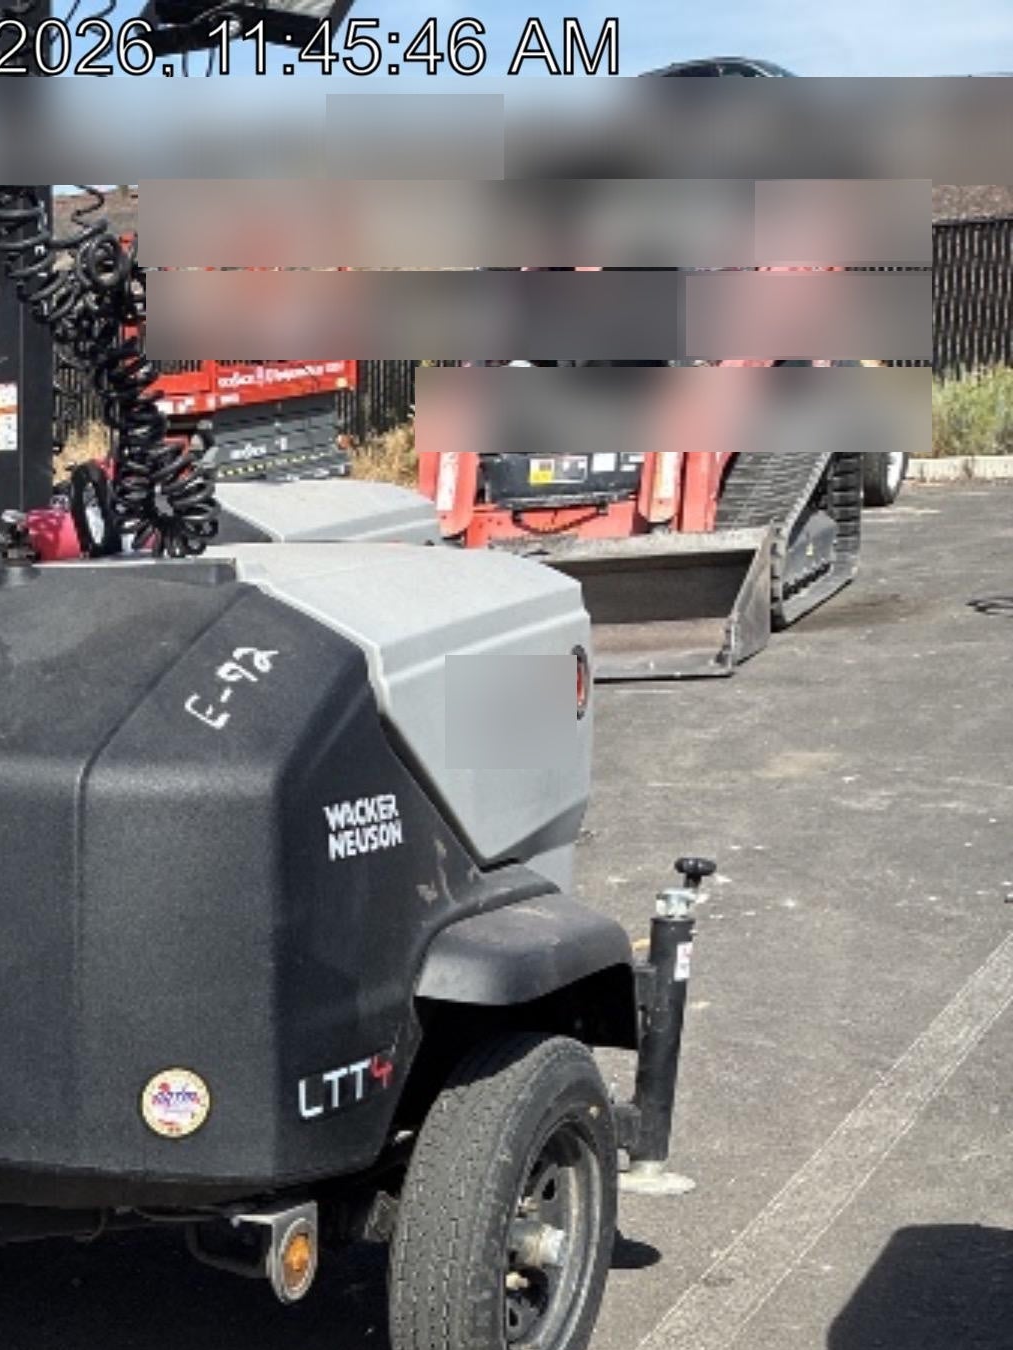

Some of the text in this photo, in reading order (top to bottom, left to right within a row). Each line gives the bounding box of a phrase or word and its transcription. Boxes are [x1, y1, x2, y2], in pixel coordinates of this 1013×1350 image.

[323, 793, 399, 832] WACKER
[329, 819, 403, 860] NEUSON
[298, 1055, 394, 1118] LTT4
